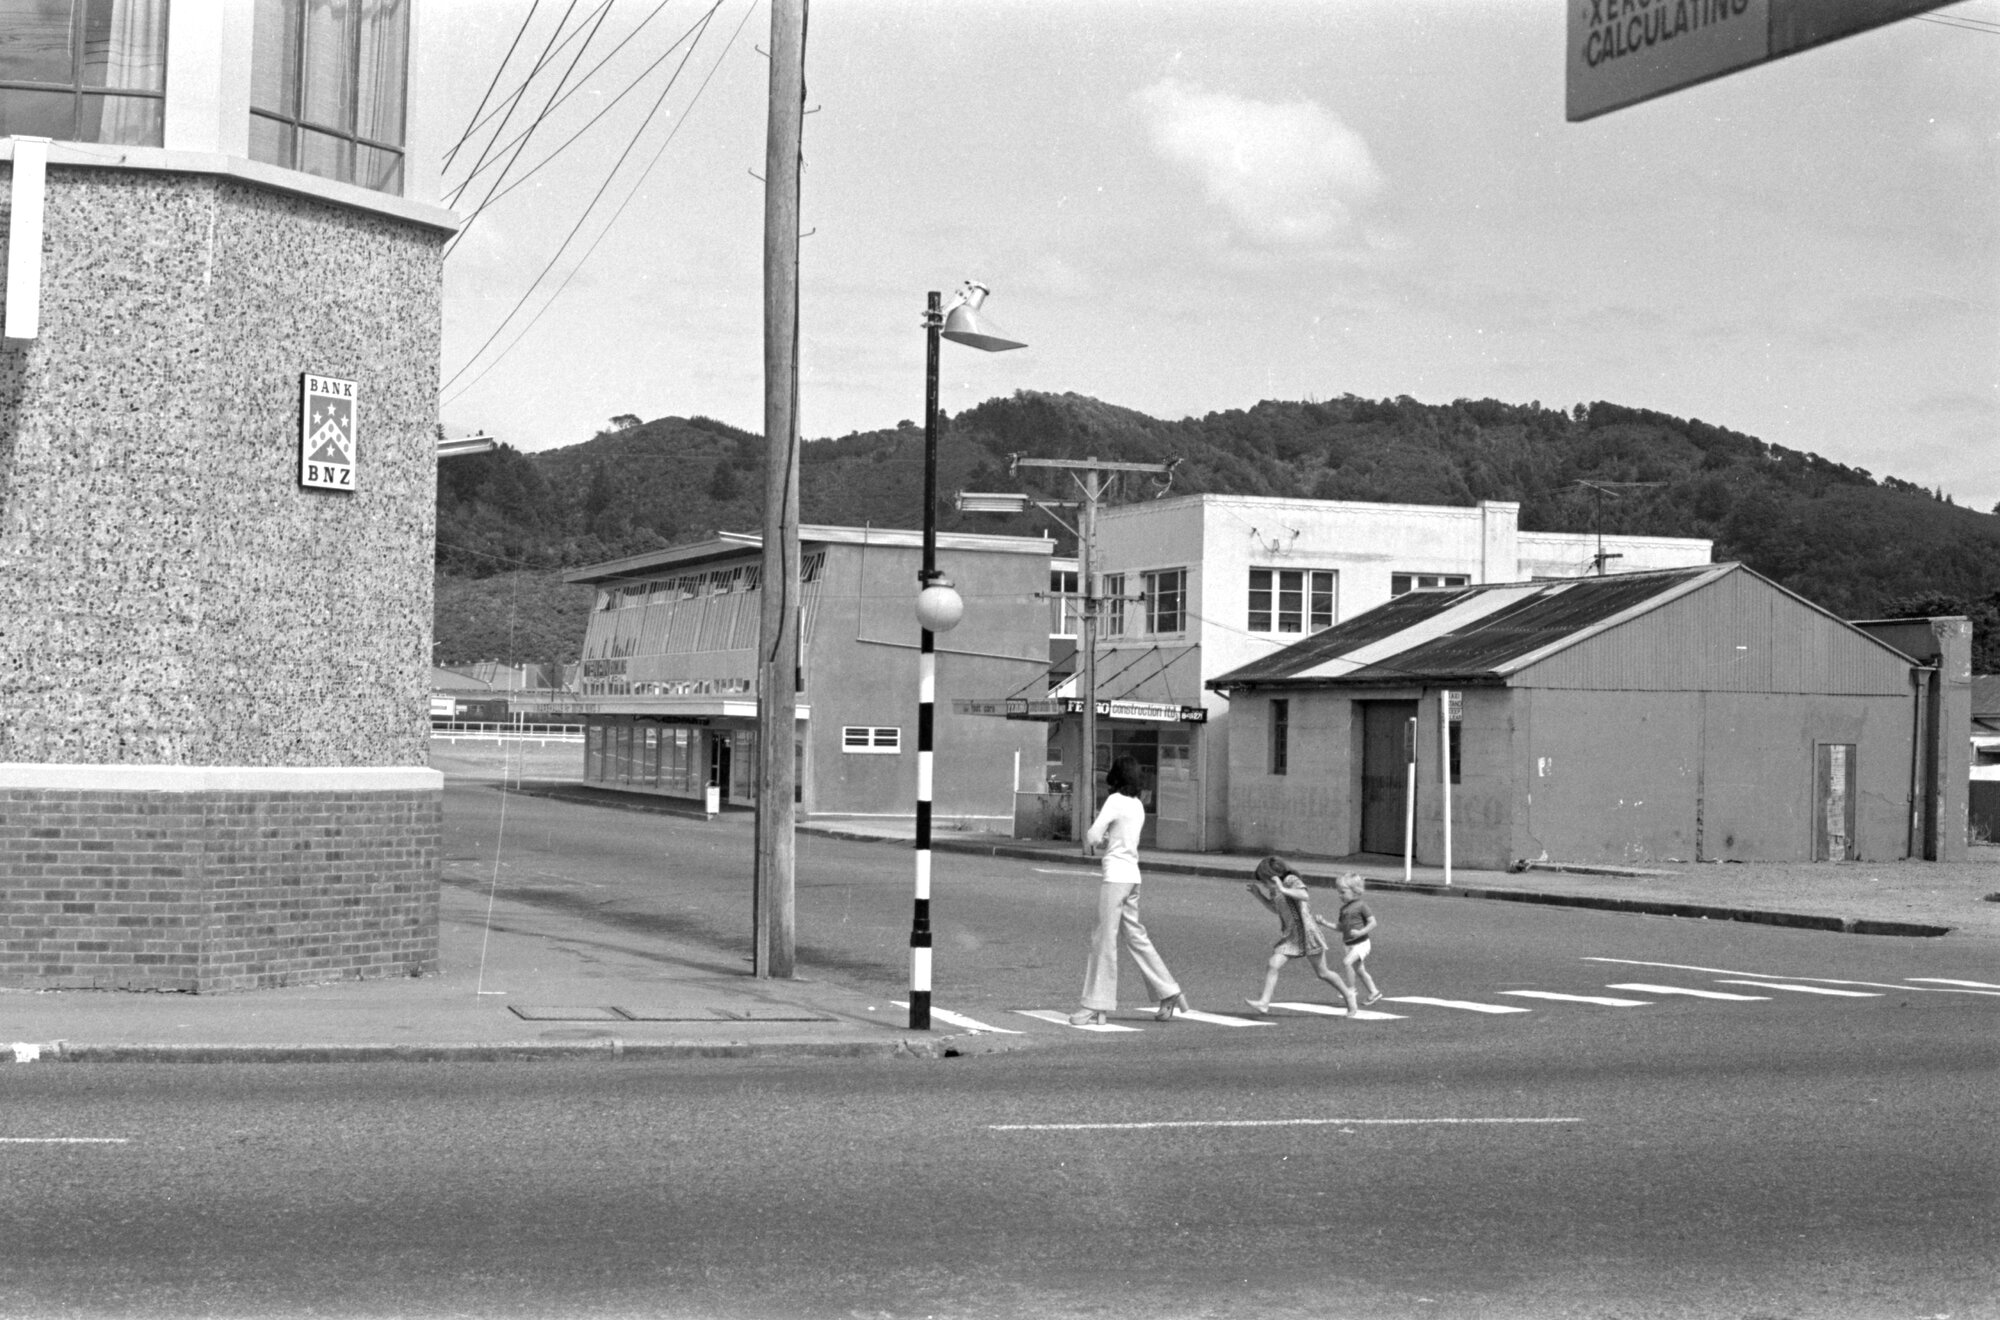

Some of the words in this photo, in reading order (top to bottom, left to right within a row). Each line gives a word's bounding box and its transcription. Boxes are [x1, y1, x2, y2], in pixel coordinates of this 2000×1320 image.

[310, 378, 352, 397] BANK
[308, 464, 350, 485] BNZ
[1112, 703, 1162, 718] construction
